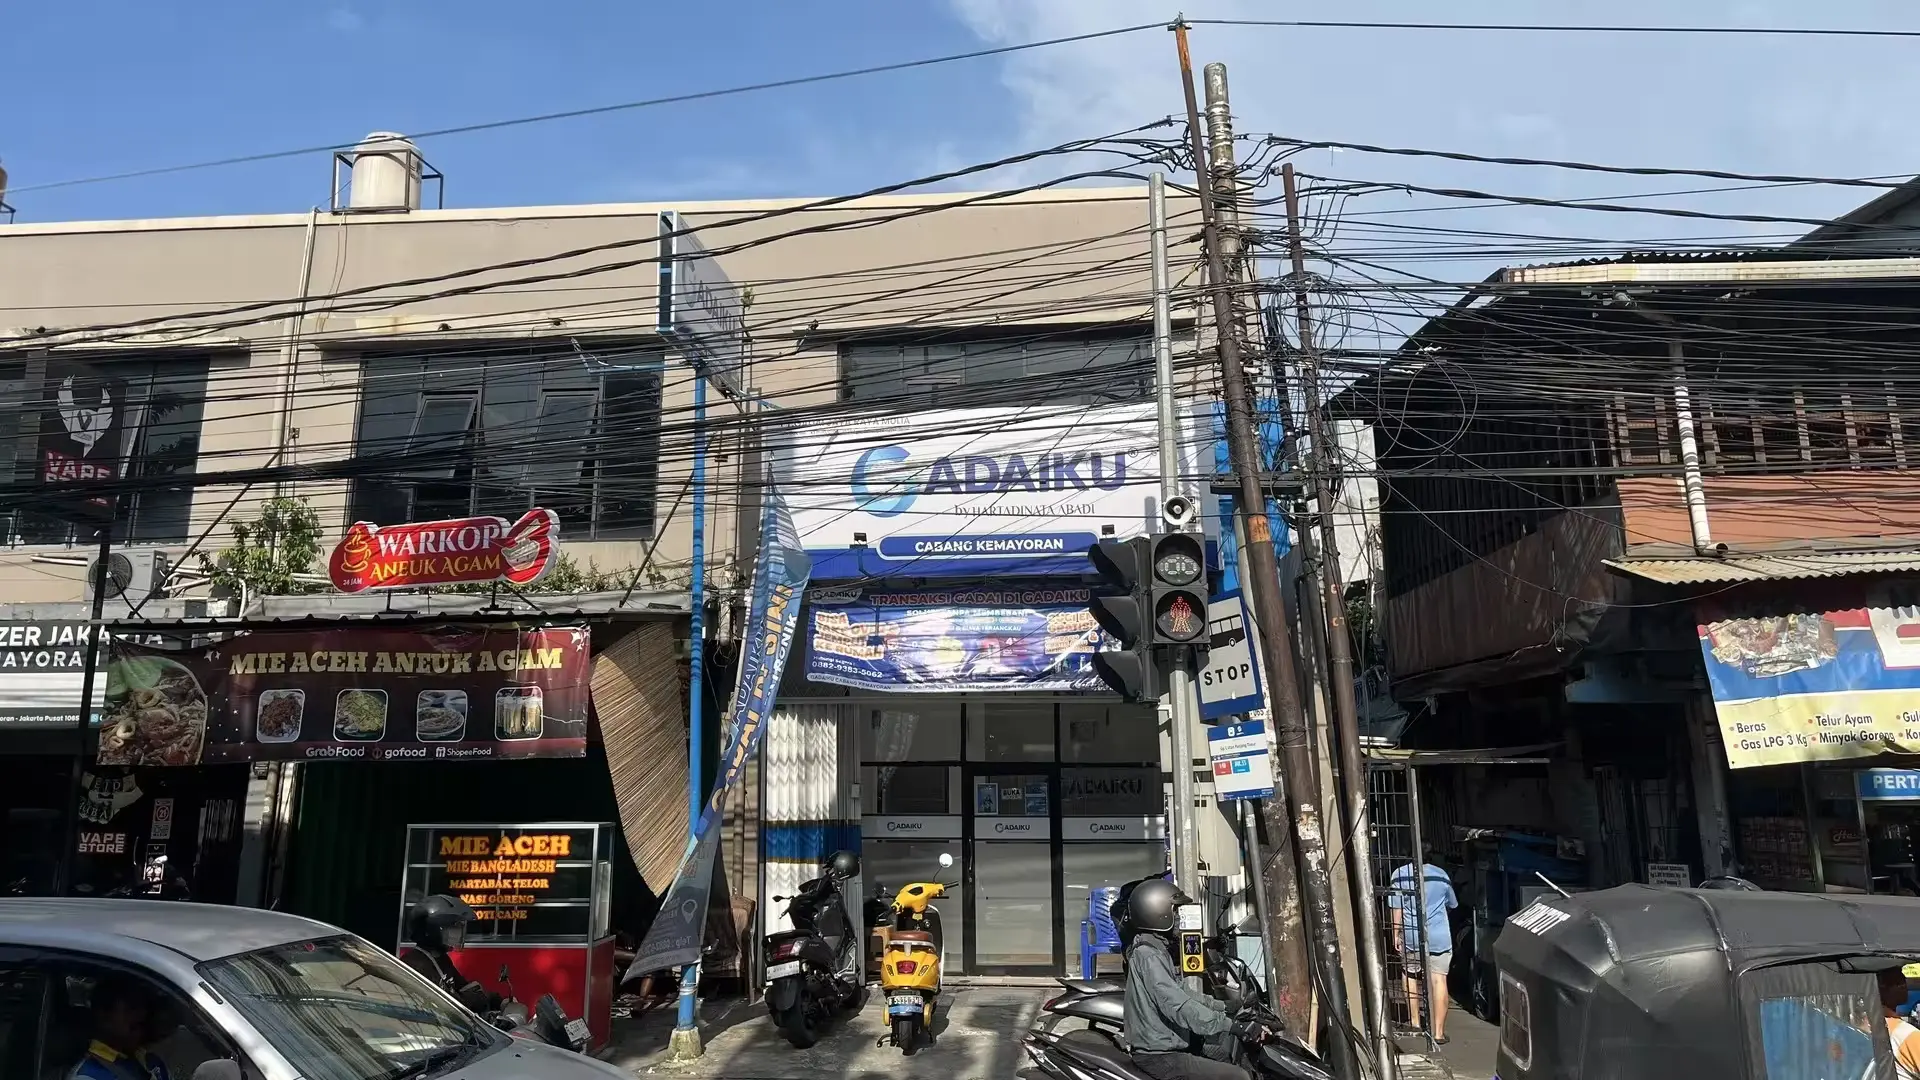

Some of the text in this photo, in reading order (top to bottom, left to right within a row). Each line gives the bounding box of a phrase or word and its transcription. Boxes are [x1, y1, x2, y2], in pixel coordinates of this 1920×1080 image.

[954, 503, 1095, 518] by HARTADINATA ABADI
[378, 524, 500, 558] WARKOP
[915, 538, 1064, 553] CABANG KEMAYORAN
[369, 553, 501, 582] ANEUK AGAM
[350, 578, 362, 586] JAM
[870, 590, 1090, 606] TRANSAKSI GADAI DI GADAIKU
[765, 584, 794, 655] SINI
[836, 644, 884, 658] RUMAH
[229, 648, 563, 675] MIE ACEH ANEUK AGAM
[1204, 663, 1250, 686] STOP
[1736, 722, 1766, 734] Beras
[1816, 716, 1842, 727] Telur
[1845, 714, 1873, 729] Ayam
[1741, 738, 1761, 750] Gas
[1764, 736, 1784, 748] LPG
[1787, 735, 1794, 746] 3
[1796, 734, 1808, 747] Kg
[1819, 731, 1856, 745] Minyak
[1859, 730, 1895, 744] Goreng
[306, 746, 492, 759] GrabFood gofood ShopeeFood
[80, 833, 125, 844] VAPE
[440, 835, 571, 856] MIE ACEH
[79, 844, 124, 853] STORE
[446, 860, 556, 873] MIE BANGLADESH
[449, 879, 549, 889] MARTABAK TELOR
[488, 894, 535, 904] GORENG
[495, 910, 527, 919] CANE
